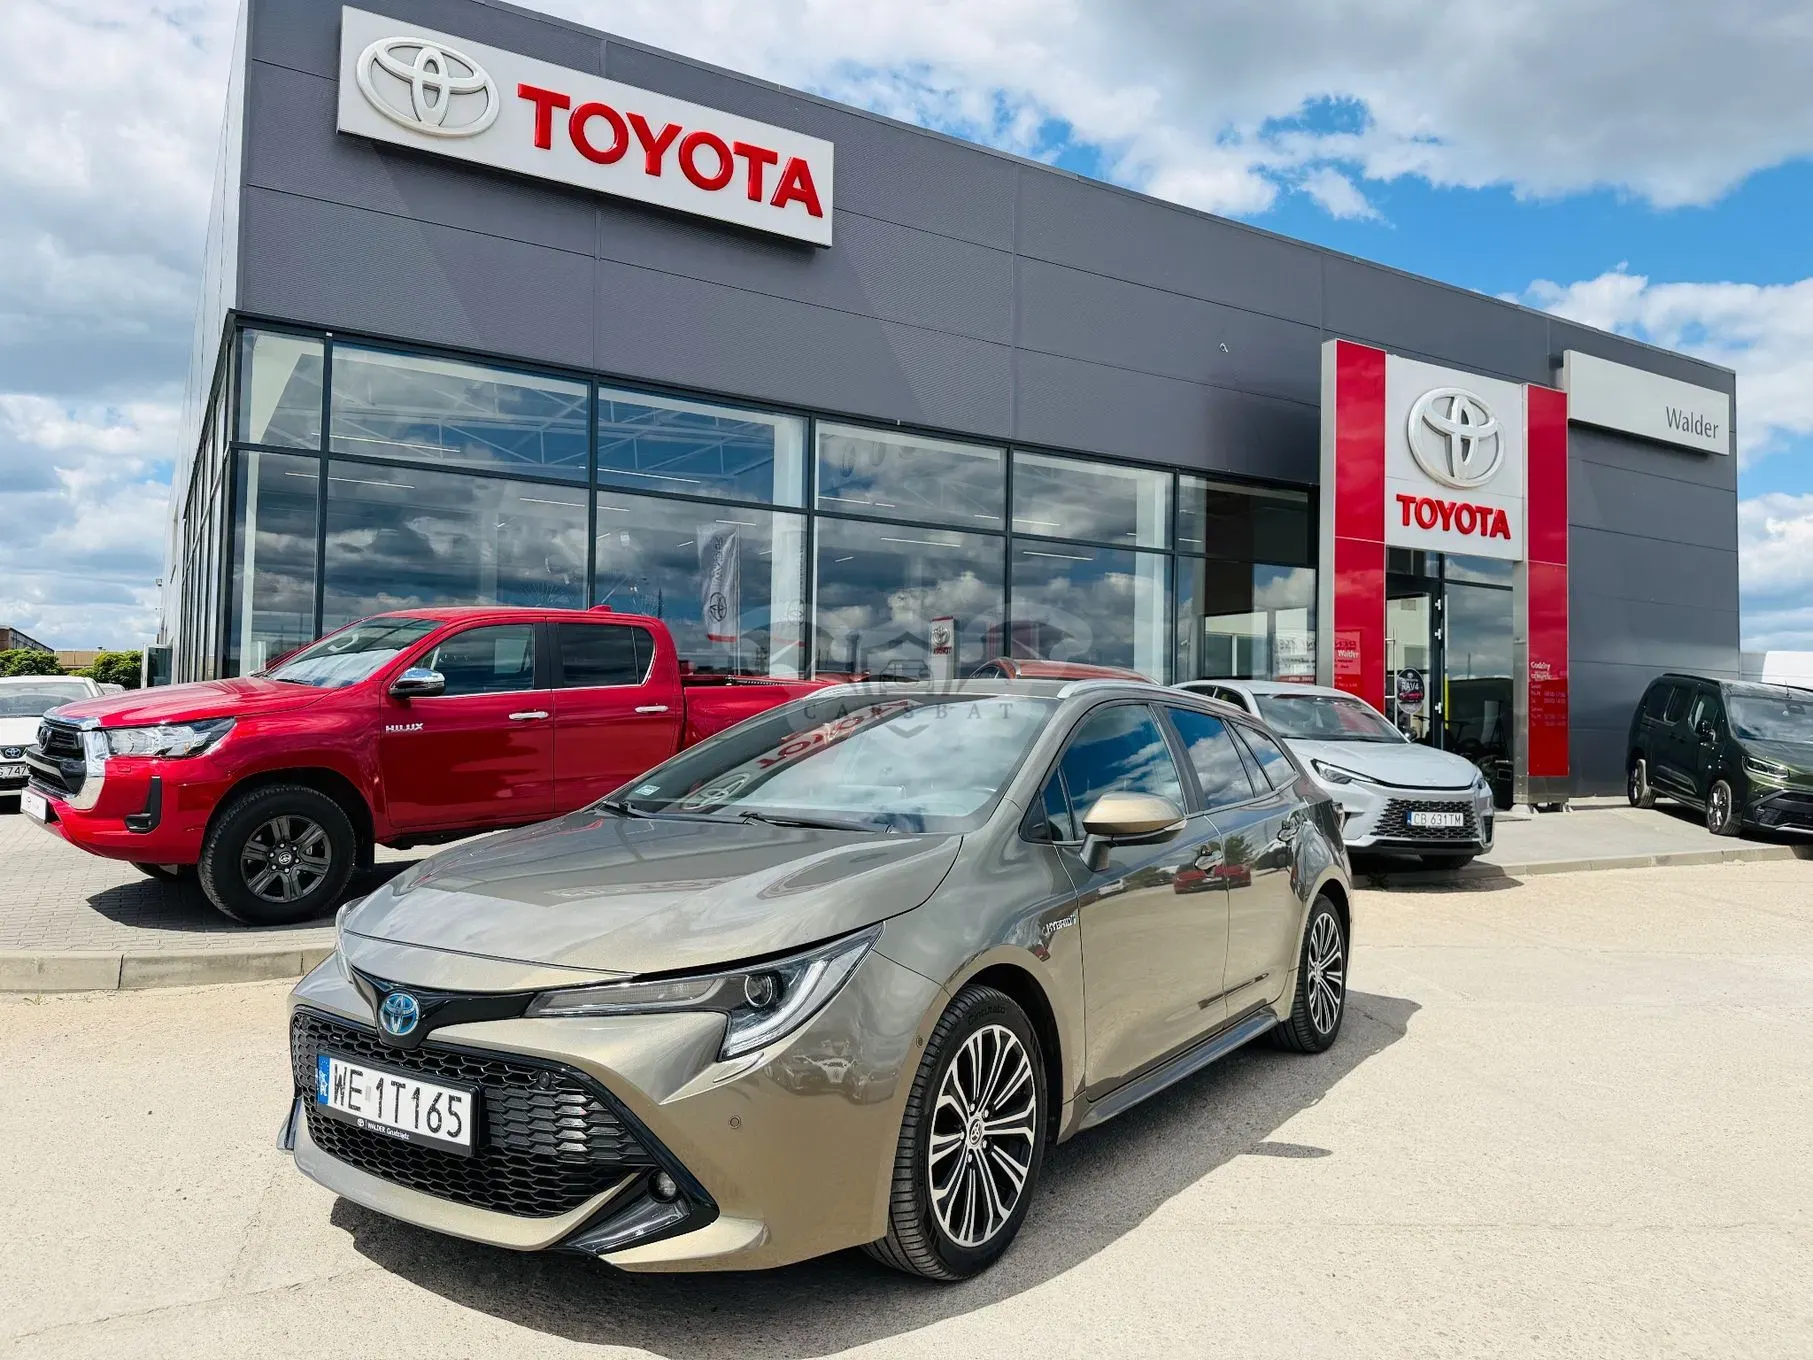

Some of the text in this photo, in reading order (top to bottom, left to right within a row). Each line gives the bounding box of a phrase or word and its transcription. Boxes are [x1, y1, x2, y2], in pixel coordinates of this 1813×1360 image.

[517, 83, 823, 219] TOYOTA
[1666, 406, 1719, 439] Walder
[1396, 494, 1511, 540] TOYOTA
[1401, 682, 1419, 691] RAV4
[385, 723, 424, 732] HILUX
[7, 766, 26, 776] 747
[1414, 813, 1461, 825] CB 631TM
[1046, 917, 1073, 932] HYBRID
[333, 1063, 462, 1138] WE 1T165
